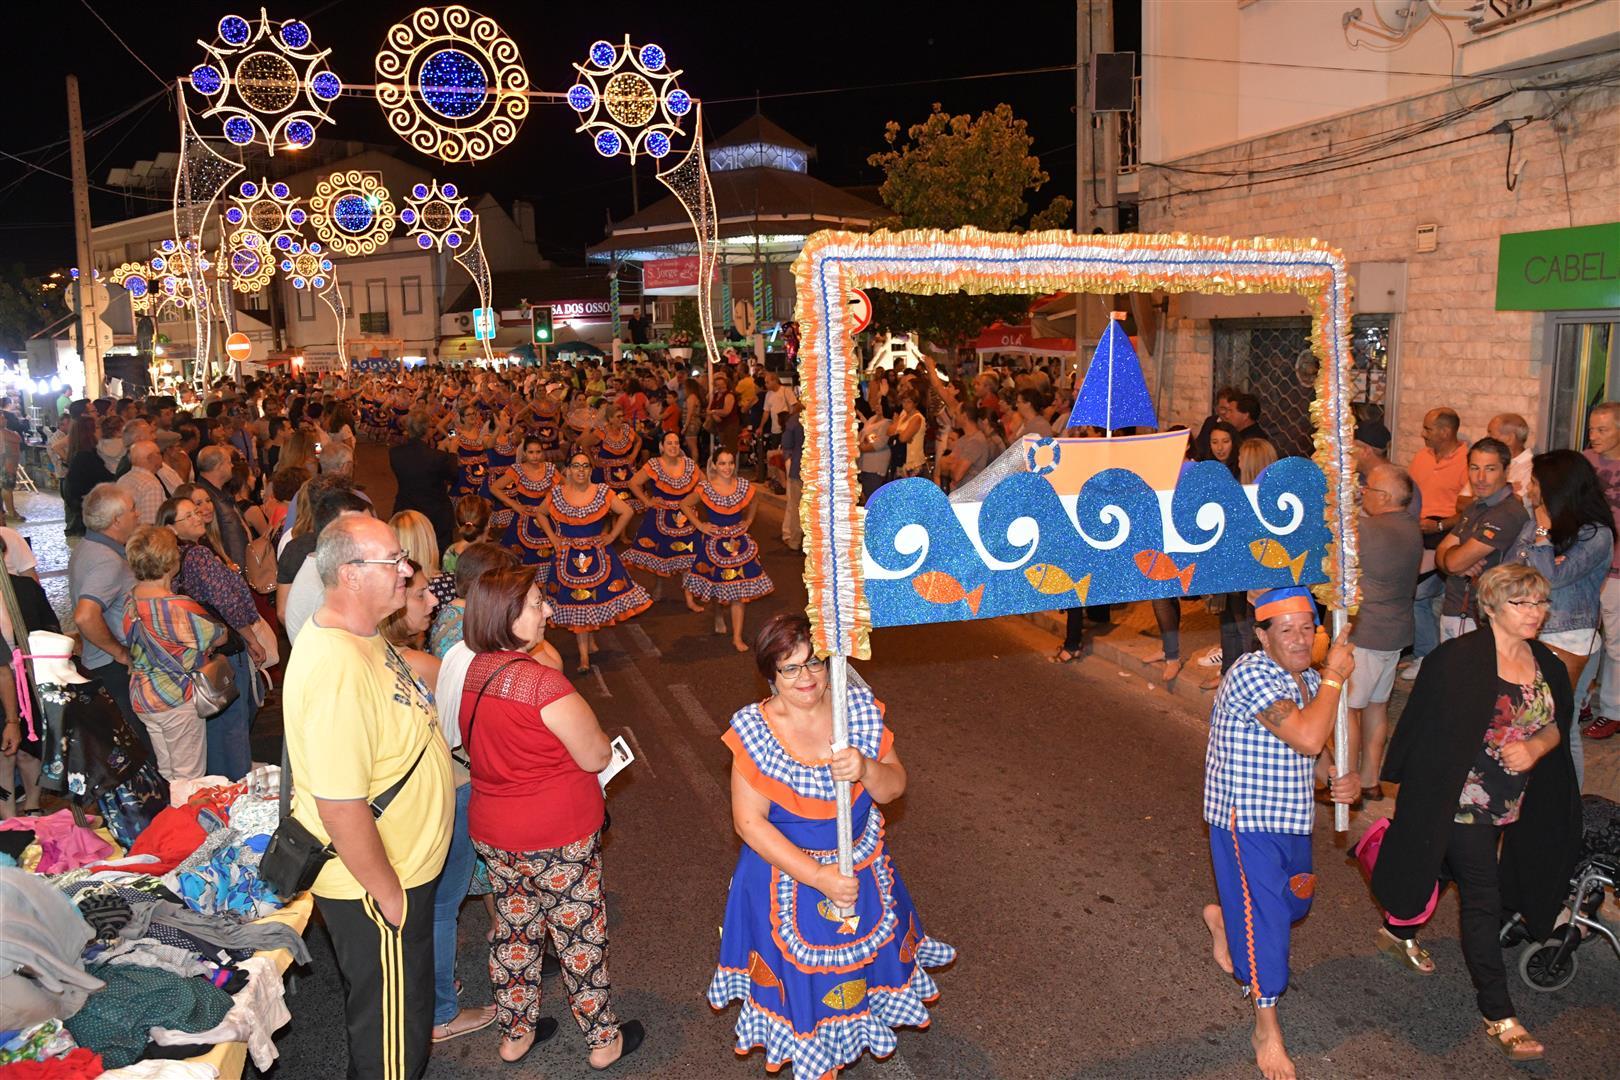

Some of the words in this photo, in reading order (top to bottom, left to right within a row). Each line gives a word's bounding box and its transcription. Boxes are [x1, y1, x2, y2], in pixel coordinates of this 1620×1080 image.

[1525, 251, 1620, 285] CABEL
[551, 304, 563, 314] SA
[564, 303, 583, 314] DOS
[585, 302, 610, 313] OSSO
